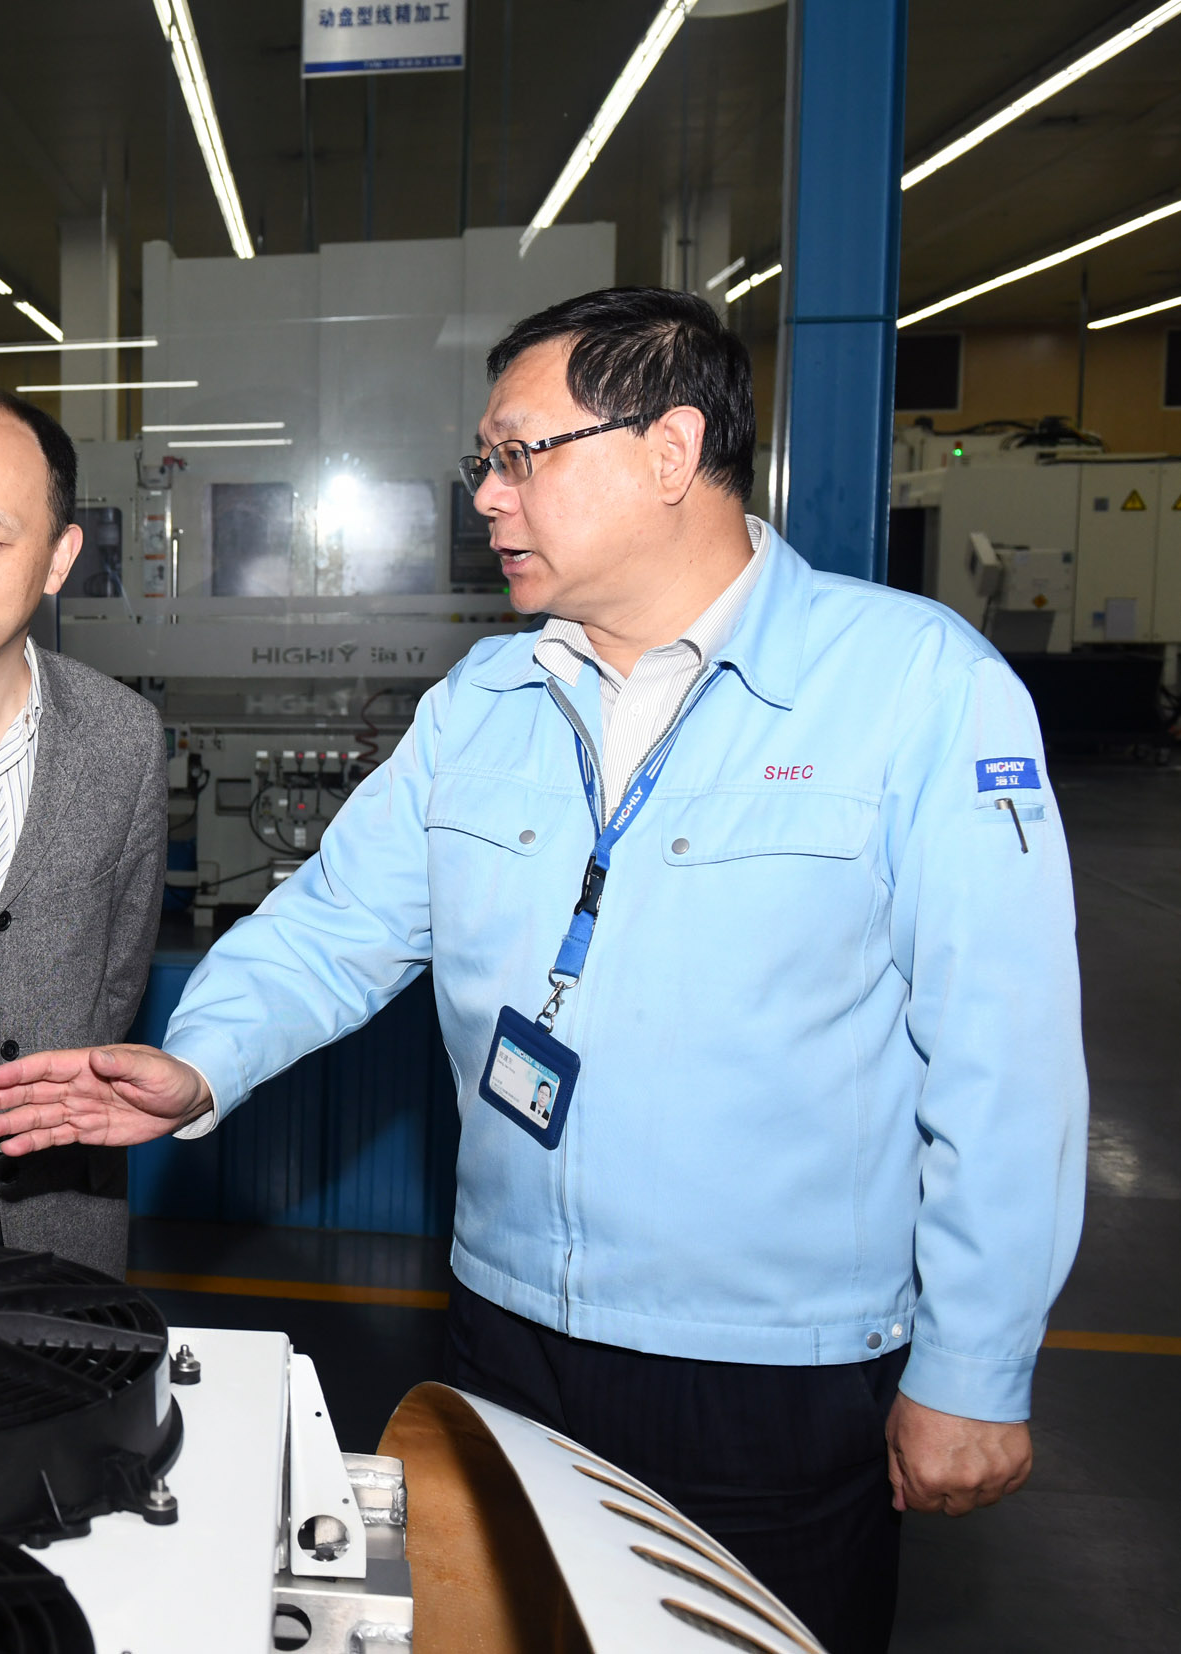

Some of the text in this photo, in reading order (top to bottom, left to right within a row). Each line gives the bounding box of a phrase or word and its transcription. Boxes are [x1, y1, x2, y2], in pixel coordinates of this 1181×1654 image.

[319, 3, 450, 28] 动盘型线精加工
[764, 765, 813, 780] SHEC
[985, 761, 1025, 773] HIGHLY
[995, 774, 1019, 786] 海立
[613, 786, 643, 831] HIGHLY
